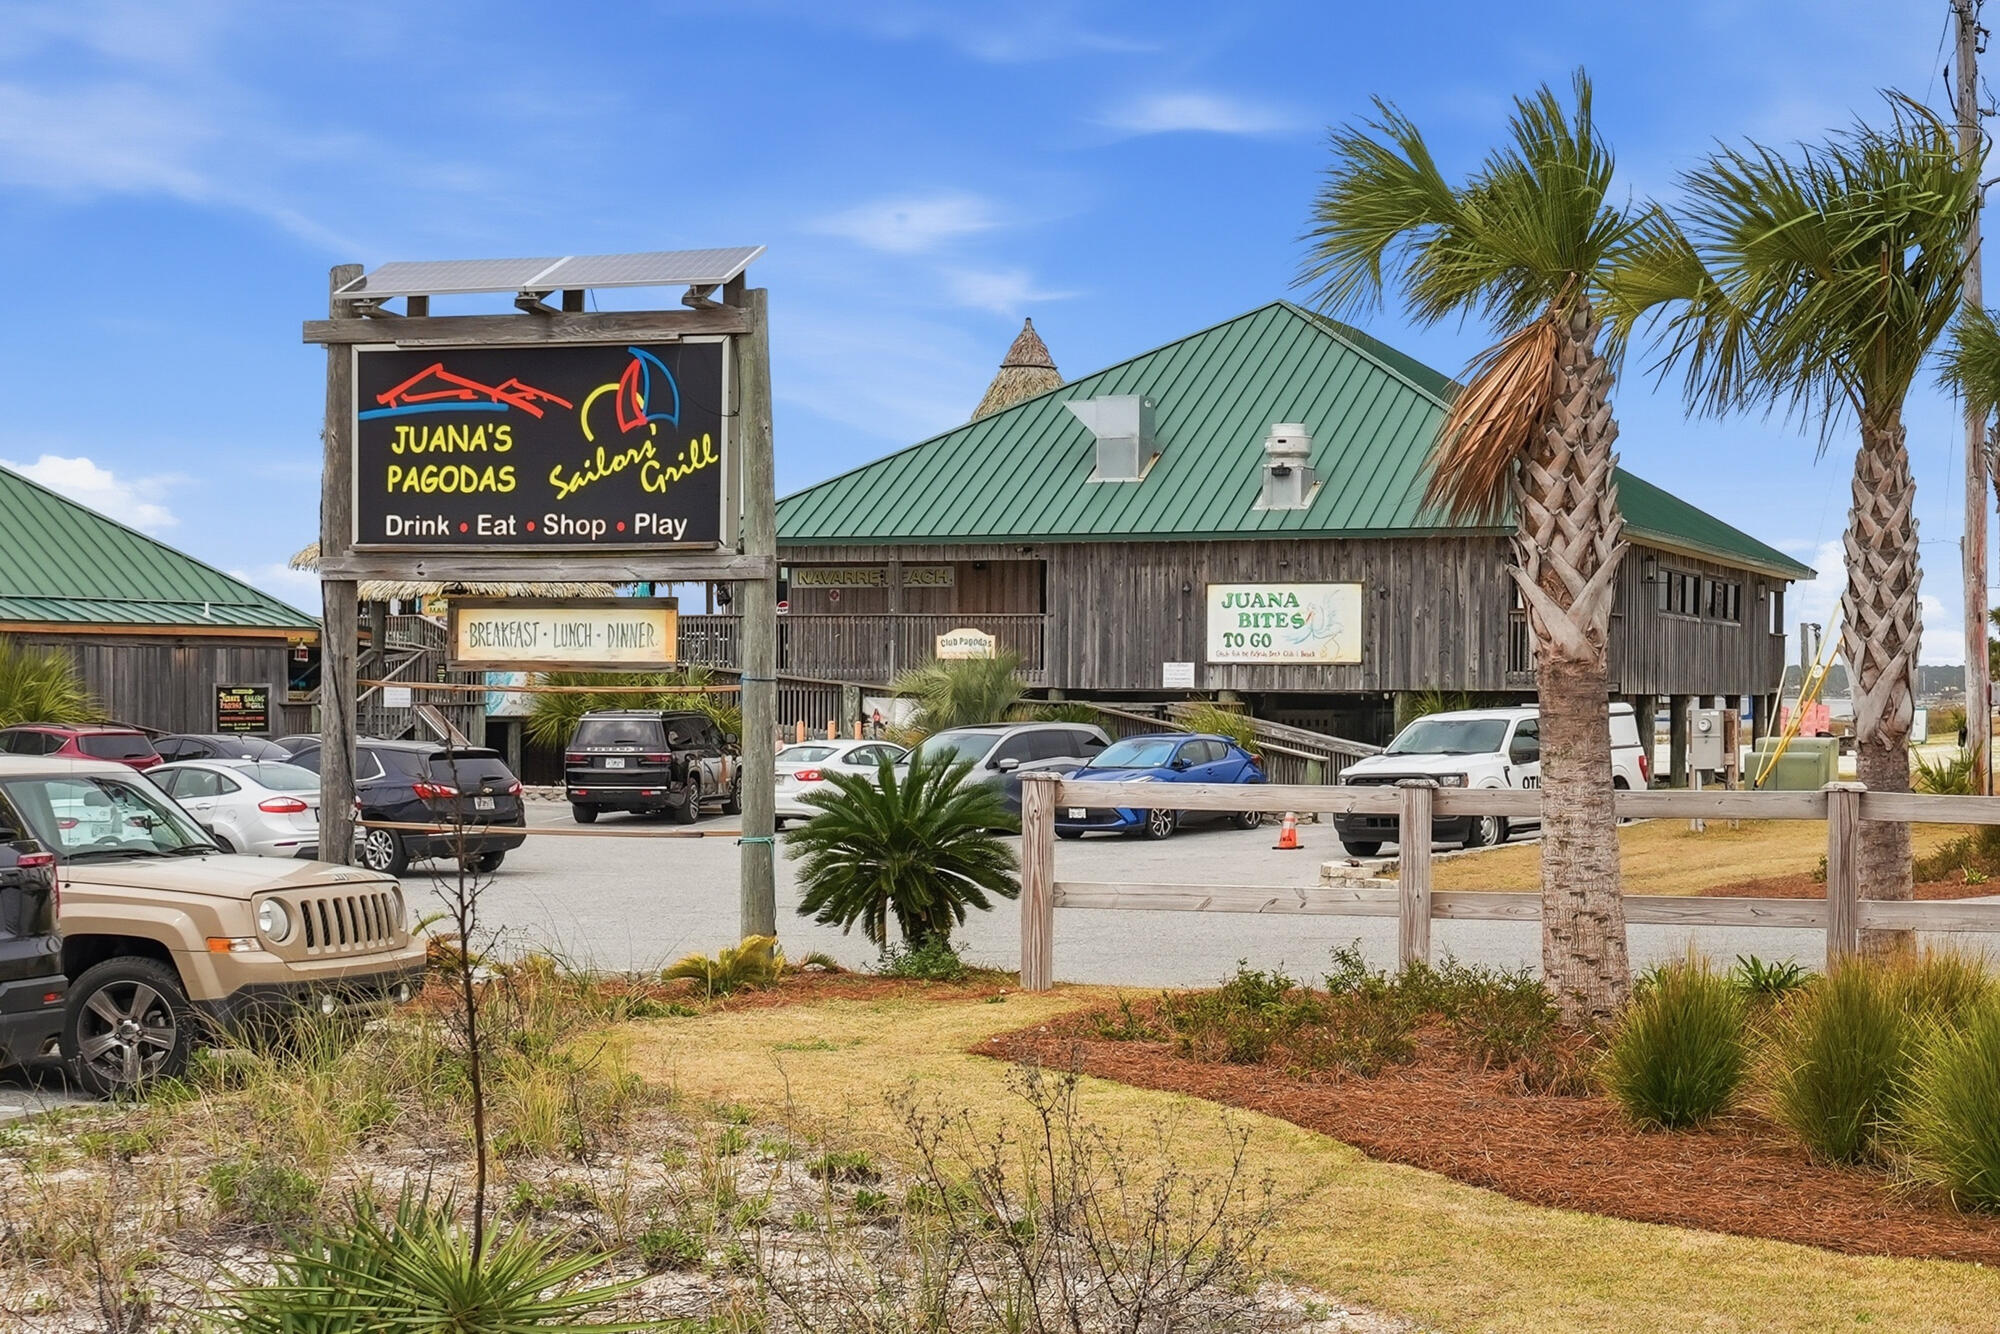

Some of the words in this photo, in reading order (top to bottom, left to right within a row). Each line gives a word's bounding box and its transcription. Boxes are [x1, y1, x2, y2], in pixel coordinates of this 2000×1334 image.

[391, 423, 513, 454] JUANA'S
[549, 423, 657, 500] Sailors'
[640, 433, 719, 493] Grill
[387, 464, 516, 493] PAGODAS
[385, 514, 450, 536] Drink
[477, 514, 517, 536] Eat
[543, 513, 607, 540] Shop
[634, 512, 688, 541] Play
[797, 569, 881, 586] NAVARRE
[886, 569, 948, 585] EACH
[1221, 592, 1300, 609] JUANA
[469, 621, 540, 648] BREAKFAST
[553, 622, 592, 648] LUNCH
[1238, 612, 1305, 629] BITES
[1223, 632, 1245, 648] TO
[1250, 632, 1272, 648] GO
